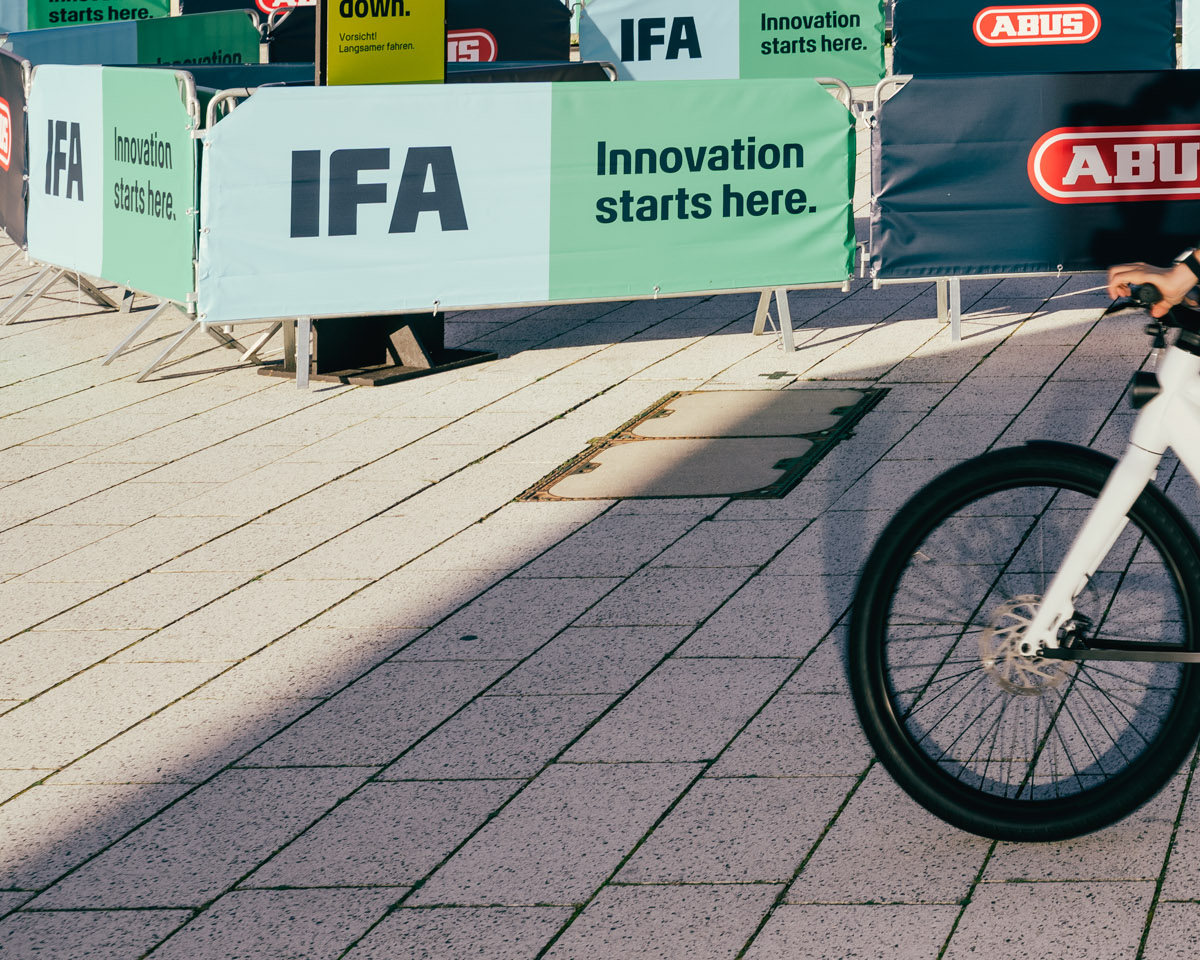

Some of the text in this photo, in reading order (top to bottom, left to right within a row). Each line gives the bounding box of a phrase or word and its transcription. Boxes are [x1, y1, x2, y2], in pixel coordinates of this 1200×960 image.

[48, 6, 154, 23] starts here.
[760, 10, 861, 32] Innovation
[990, 12, 1083, 38] ABUS
[338, 42, 415, 54] Langsamer fahren.
[339, 32, 377, 42] Vorsicht!
[620, 16, 702, 62] IFA
[760, 33, 868, 56] starts here.
[45, 119, 84, 202] IFA
[114, 127, 173, 170] Innovation
[596, 136, 805, 176] Innovation
[113, 178, 176, 221] starts here.
[290, 145, 469, 238] IFA
[595, 183, 817, 224] starts here.
